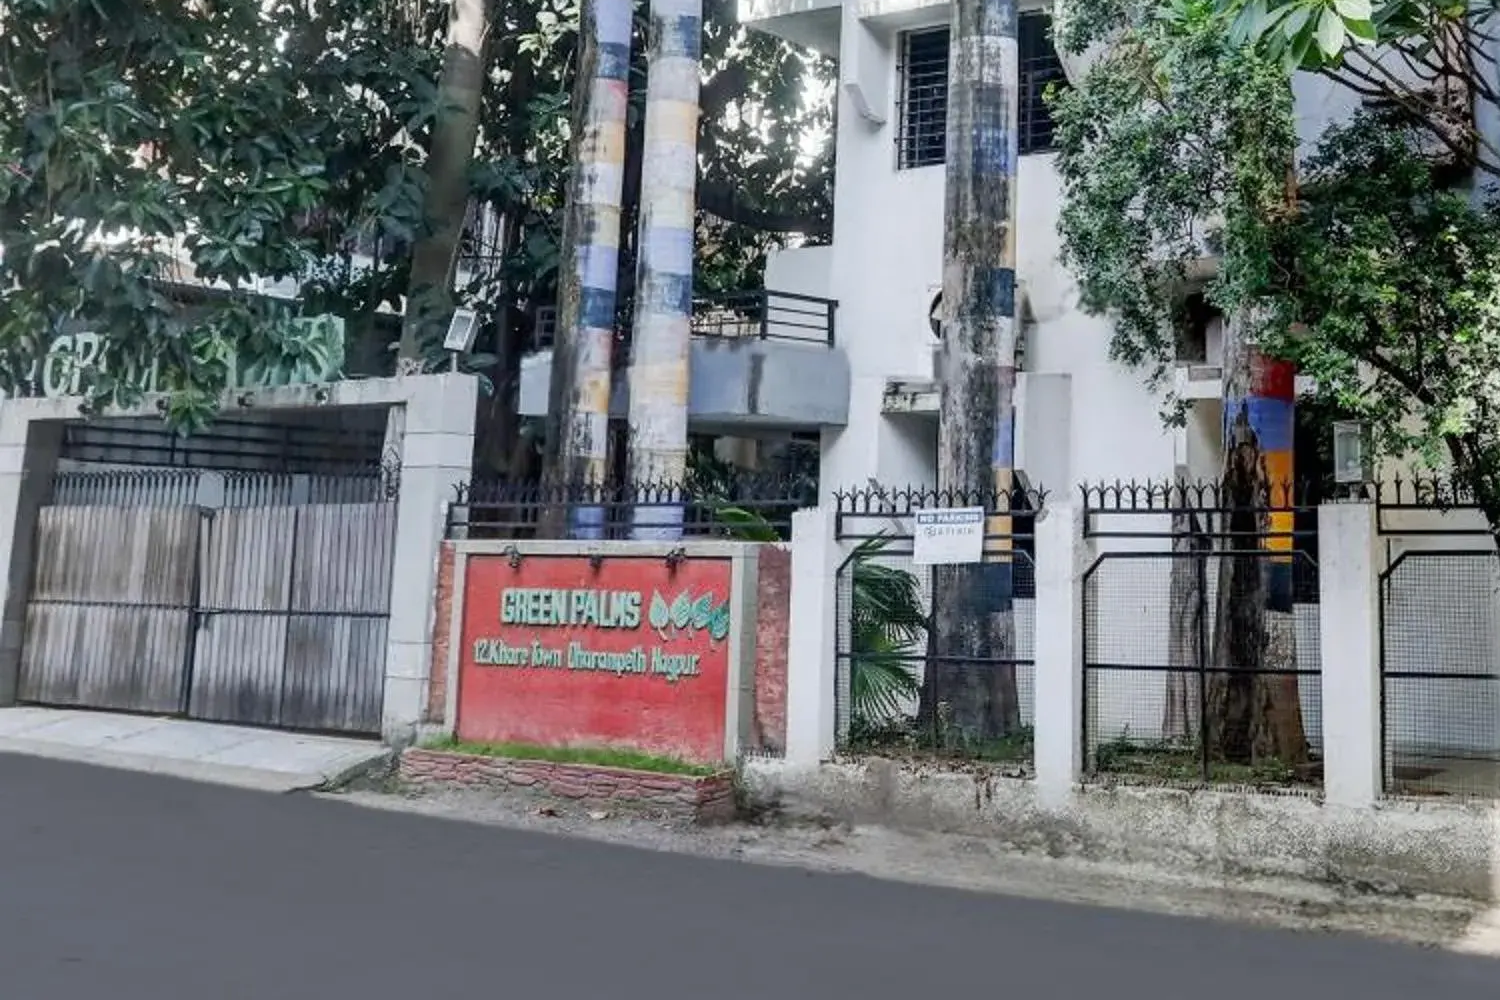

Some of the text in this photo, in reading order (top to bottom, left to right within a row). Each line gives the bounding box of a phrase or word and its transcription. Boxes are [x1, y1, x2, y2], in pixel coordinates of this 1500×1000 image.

[501, 588, 642, 628] GREEN PALMS
[531, 638, 562, 667] Town
